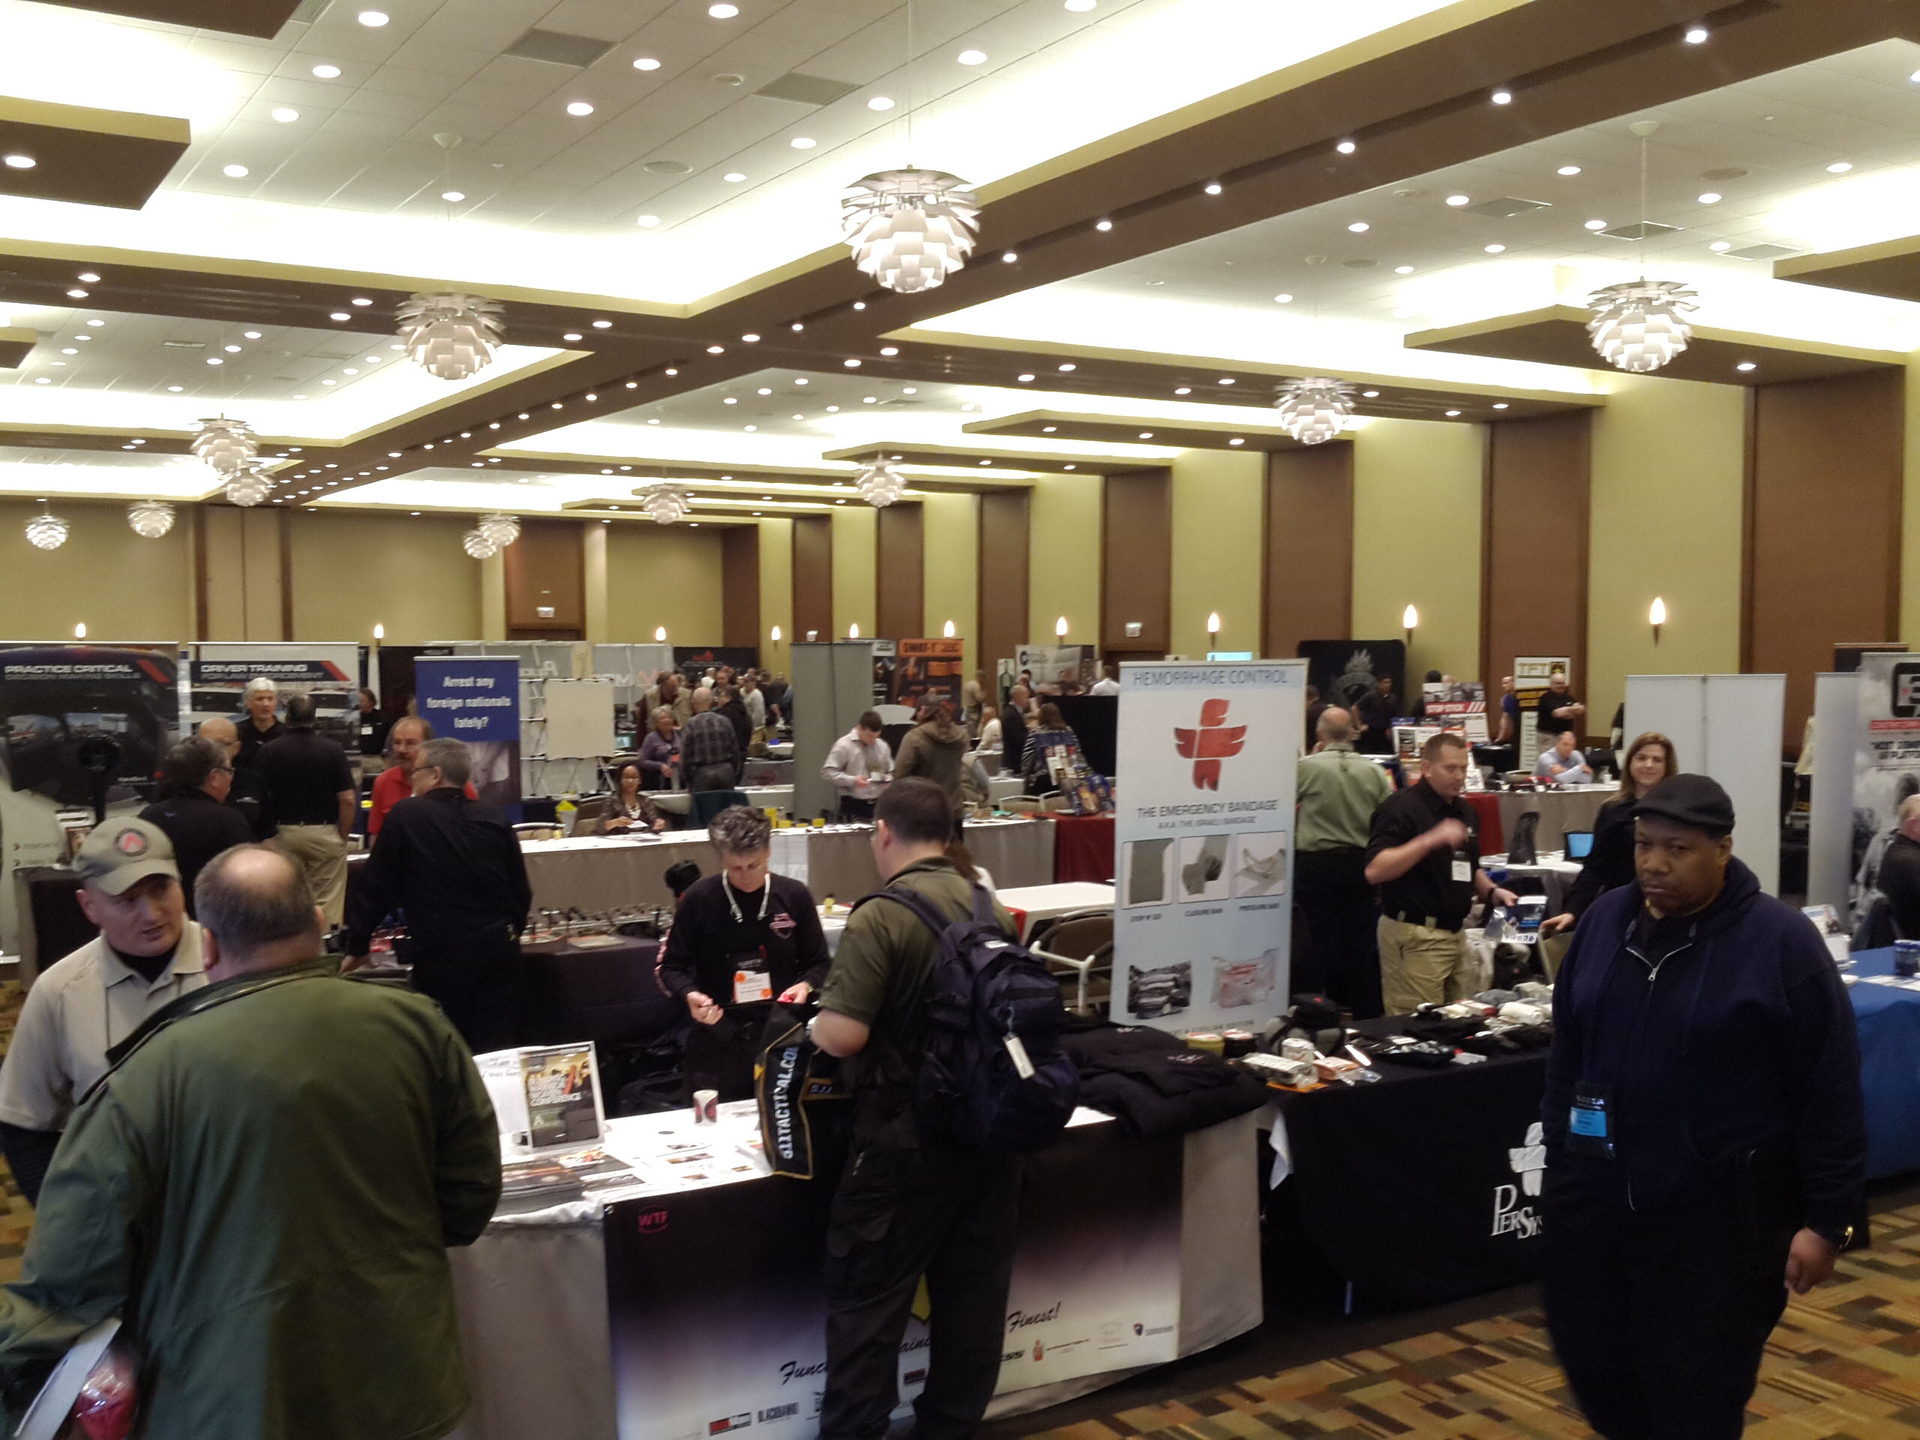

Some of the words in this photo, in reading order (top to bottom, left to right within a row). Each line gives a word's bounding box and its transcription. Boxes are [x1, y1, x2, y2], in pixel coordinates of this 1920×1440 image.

[4, 664, 72, 674] PRACTICE
[73, 664, 133, 673] CRITICAL
[201, 664, 249, 673] DRIVER
[250, 664, 308, 673] TRAINING
[443, 675, 475, 688] Arrest
[476, 677, 495, 689] any
[1133, 670, 1226, 686] HEMORRHAGE
[1228, 669, 1289, 685] CONTROL
[427, 697, 464, 710] foreign
[465, 695, 512, 707] nationals
[453, 715, 489, 730] lately?
[1137, 806, 1157, 818] THE
[1159, 802, 1225, 816] EMERGENCY
[1228, 799, 1279, 813] BANDAGE
[637, 1210, 669, 1227] WTF
[780, 1359, 828, 1386] Func
[1007, 1301, 1062, 1333] Finest!
